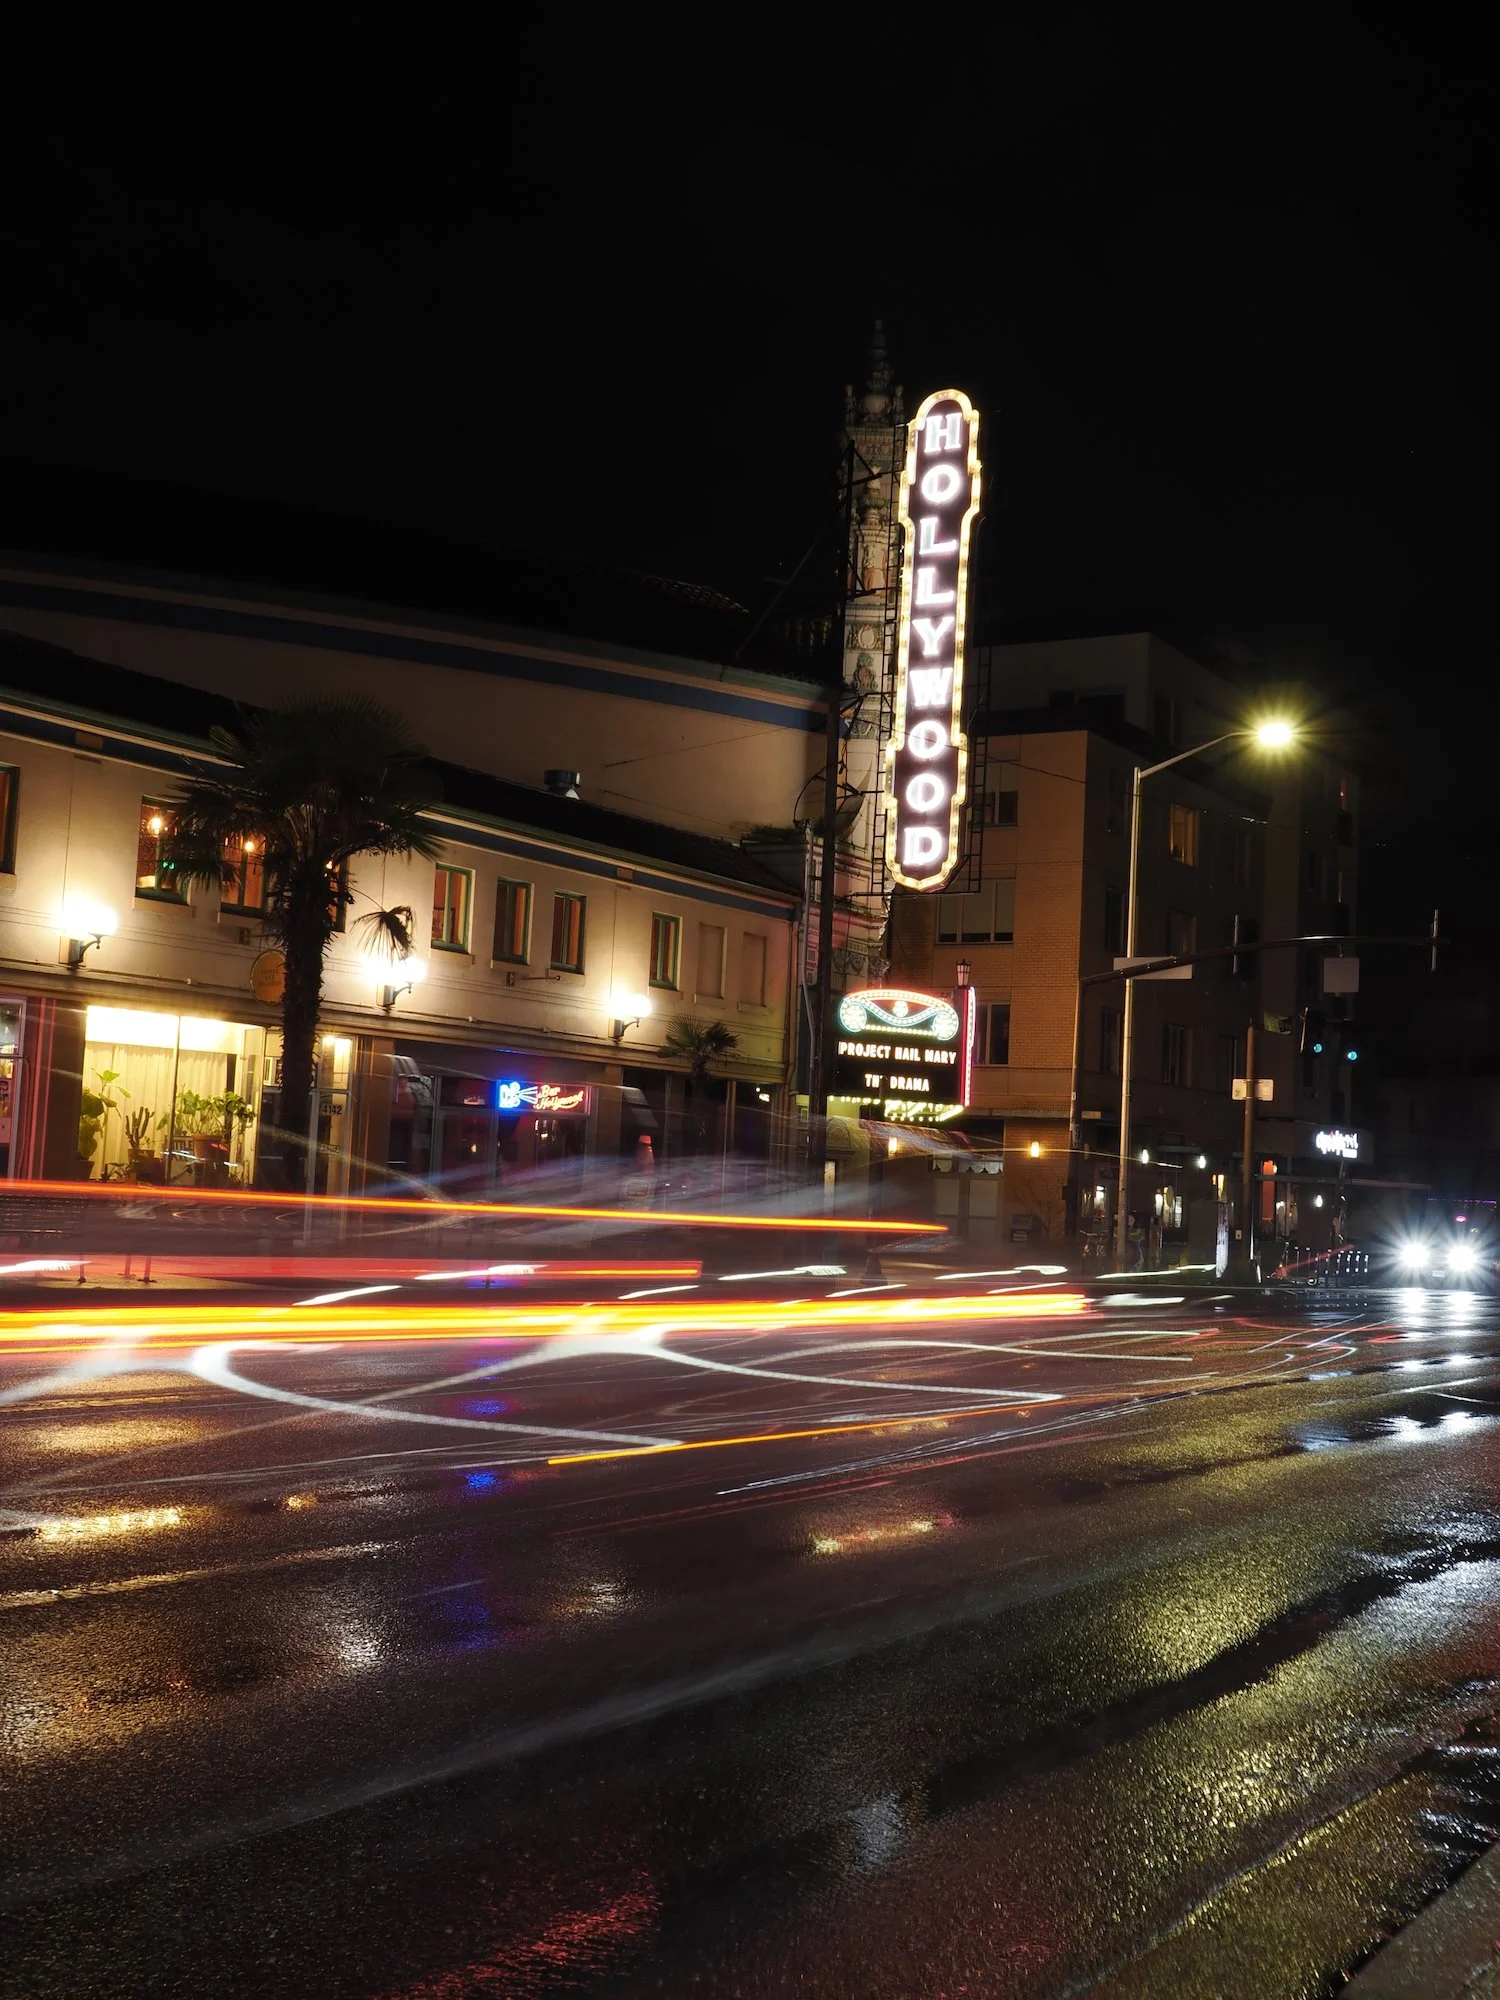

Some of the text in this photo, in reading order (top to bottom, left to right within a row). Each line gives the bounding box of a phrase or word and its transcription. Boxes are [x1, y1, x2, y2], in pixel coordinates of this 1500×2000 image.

[903, 411, 962, 866] HOLLYWOOD
[838, 1041, 957, 1064] PROJECT HAIL MARY
[536, 1084, 561, 1099] Bar
[864, 1074, 930, 1092] TH DRAMA
[321, 1104, 342, 1115] 4142
[533, 1091, 584, 1111] Hollywood
